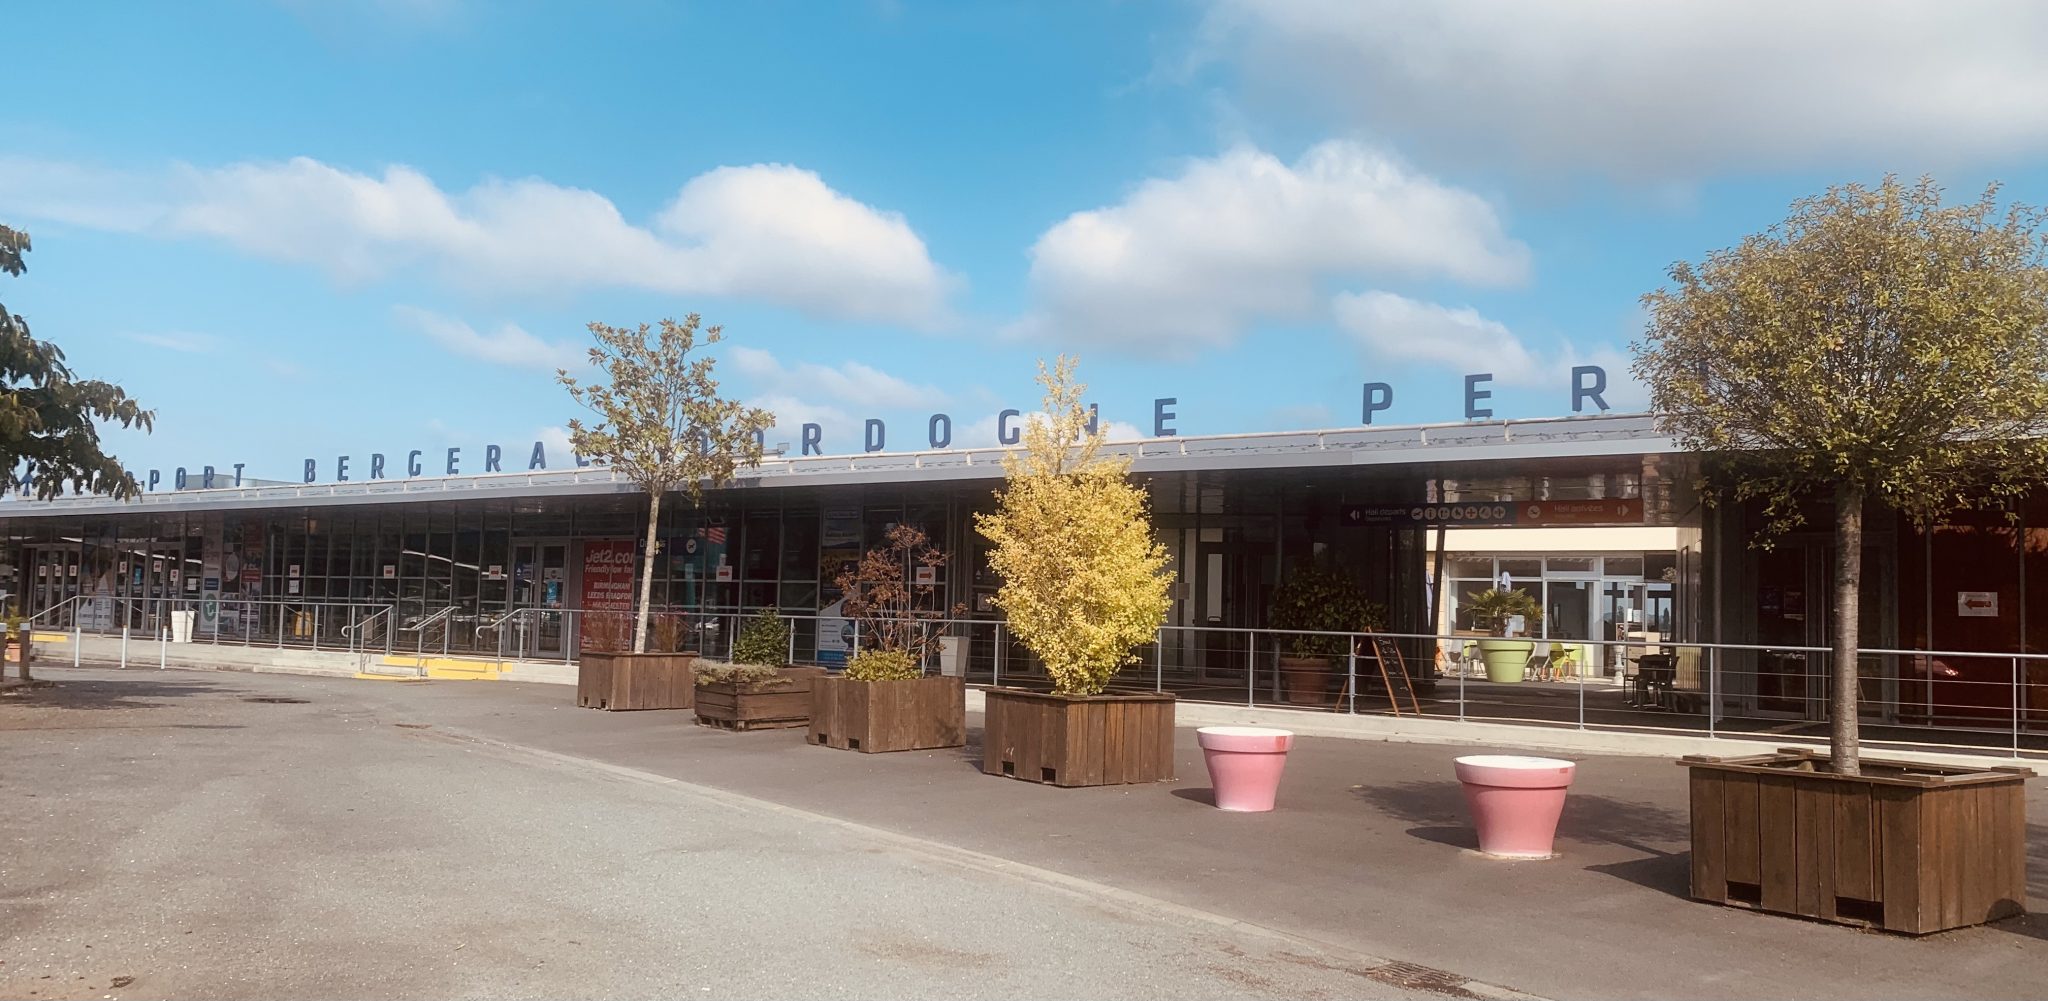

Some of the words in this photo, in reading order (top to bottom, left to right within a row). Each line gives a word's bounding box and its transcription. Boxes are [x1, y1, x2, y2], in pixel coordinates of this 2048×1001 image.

[1362, 364, 1612, 425] PER
[585, 564, 610, 574] Friendly
[587, 591, 604, 599] LEEDS
